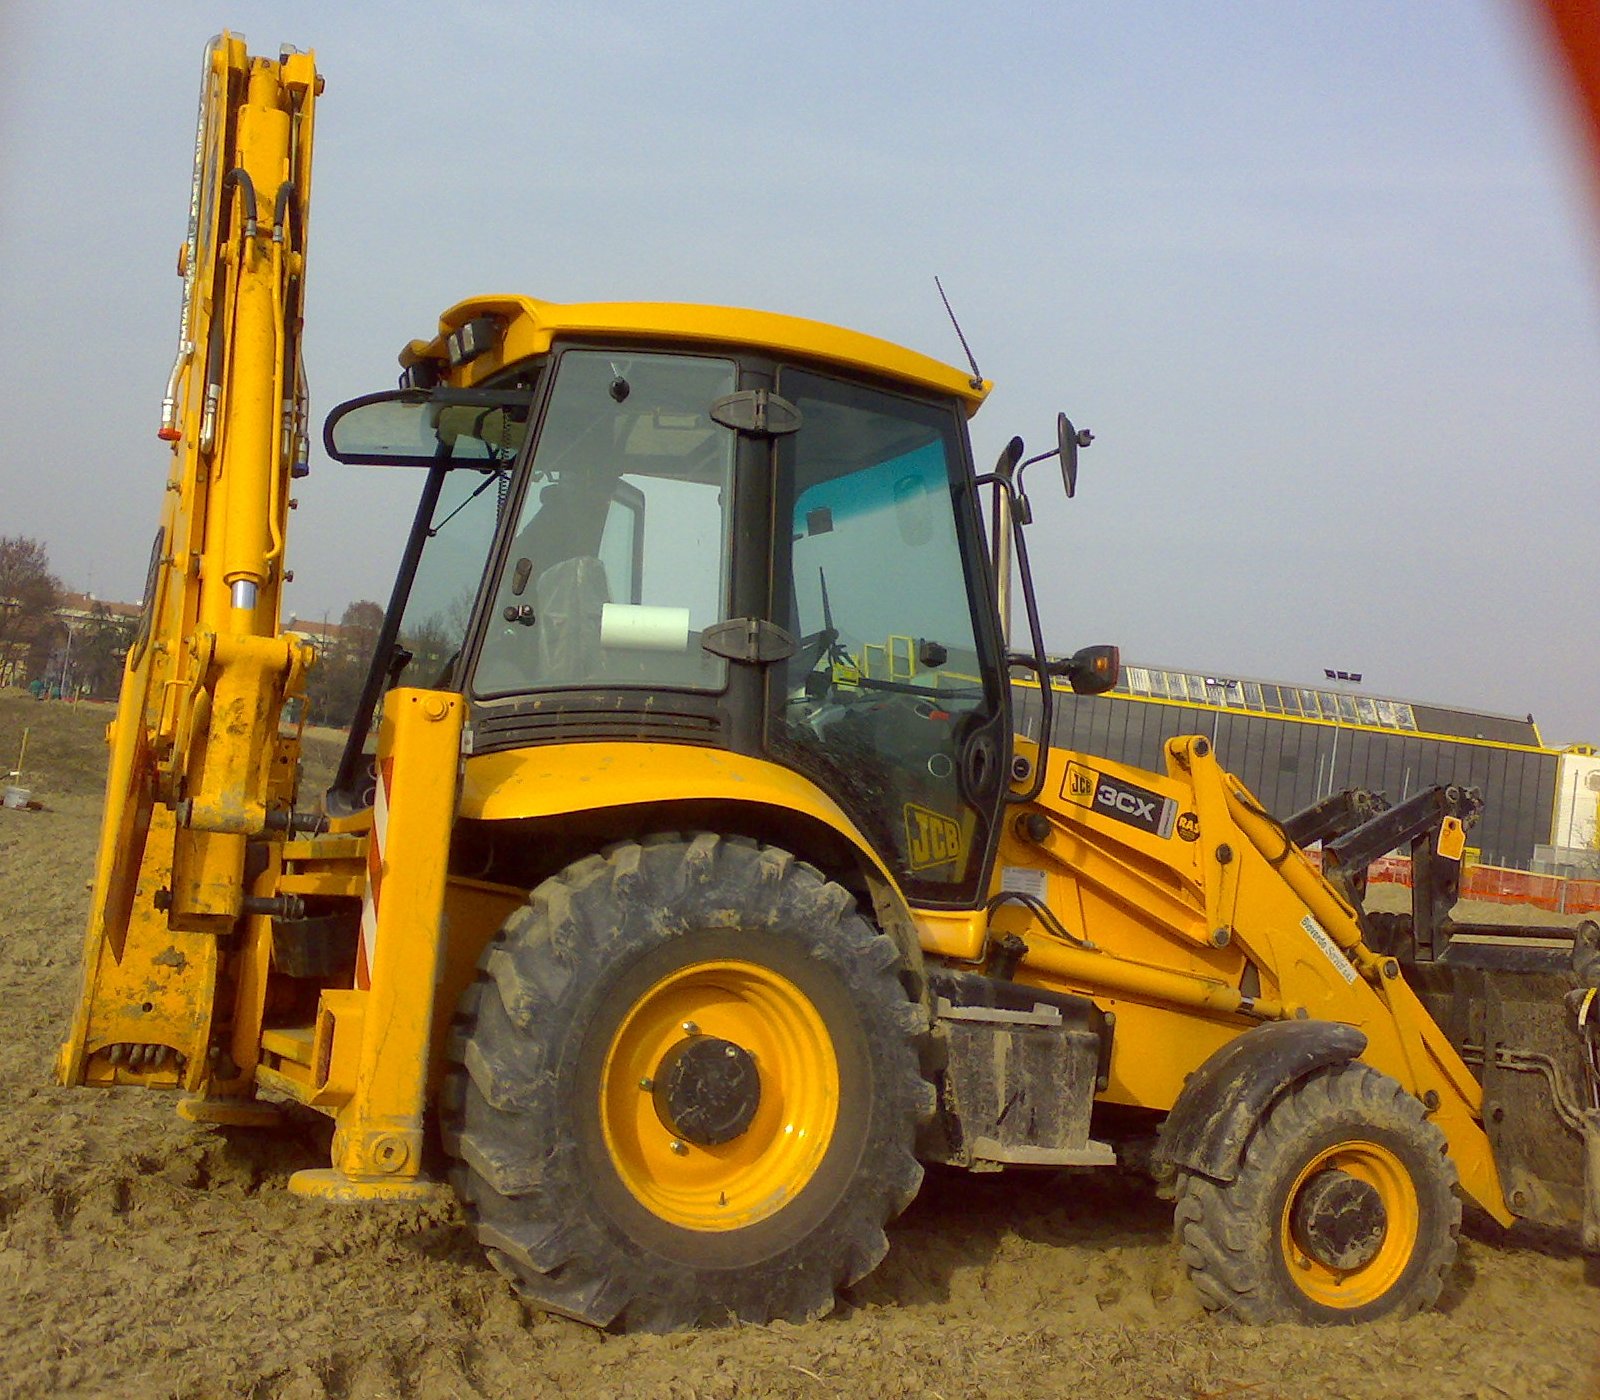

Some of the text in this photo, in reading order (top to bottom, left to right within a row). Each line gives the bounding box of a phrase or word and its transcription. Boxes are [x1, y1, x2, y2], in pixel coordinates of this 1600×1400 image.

[1072, 773, 1091, 793] JCB
[1097, 785, 1156, 822] 3CX
[912, 811, 960, 862] JCB
